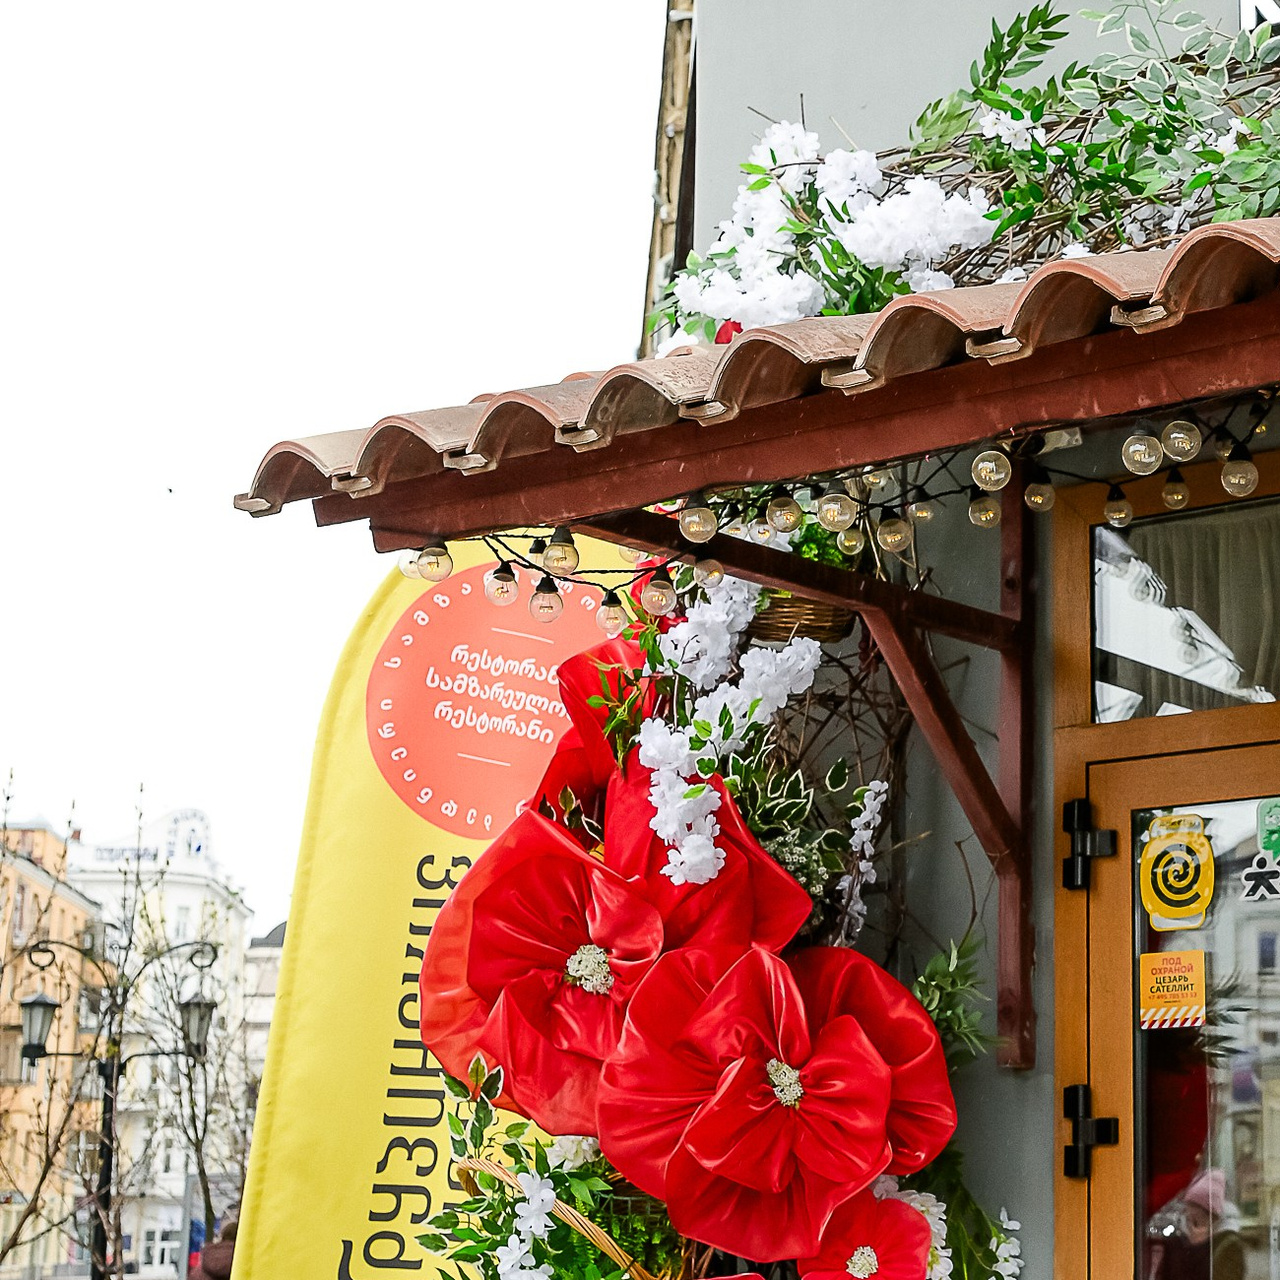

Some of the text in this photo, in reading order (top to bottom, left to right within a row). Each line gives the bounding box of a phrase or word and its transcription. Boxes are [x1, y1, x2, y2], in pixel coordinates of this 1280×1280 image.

[1162, 956, 1182, 966] ПОД
[1151, 963, 1194, 976] ОХРАНОЙ
[1155, 975, 1189, 986] ЦЕЗАРЬ
[1149, 983, 1195, 994] САТЕЛЛИТ
